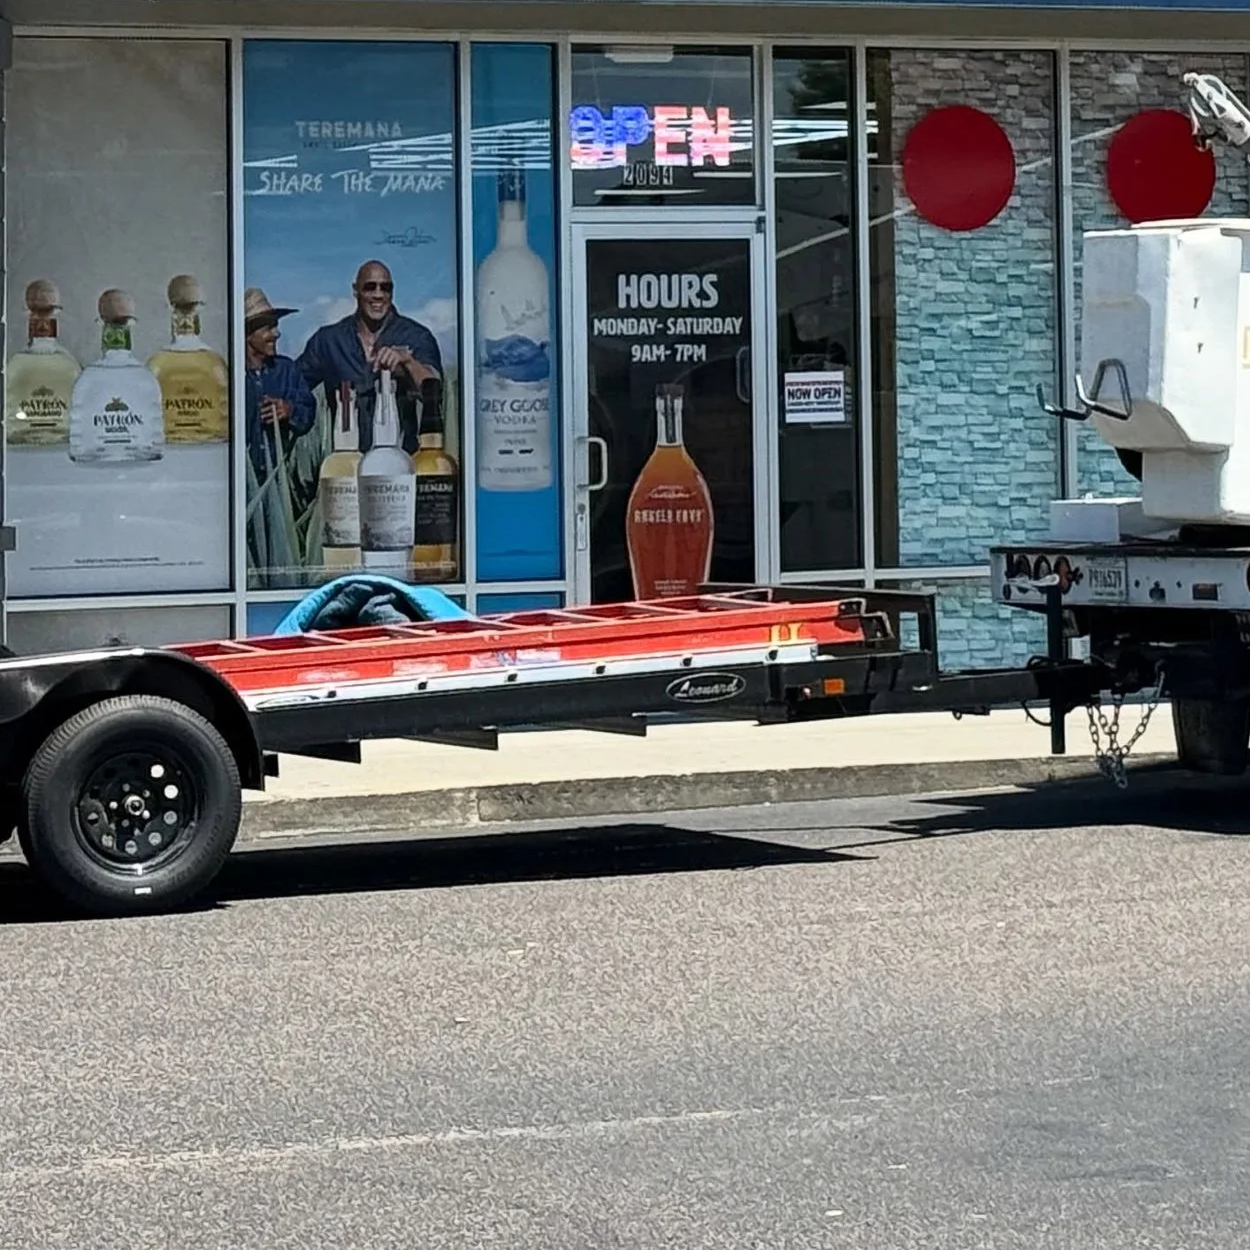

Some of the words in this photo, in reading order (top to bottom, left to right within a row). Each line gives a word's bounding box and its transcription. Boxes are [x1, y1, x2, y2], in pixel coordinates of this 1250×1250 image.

[296, 121, 403, 139] TEREMANA
[569, 105, 730, 168] OPEN
[260, 171, 324, 194] SHARE
[331, 169, 376, 194] THE
[381, 173, 446, 198] MANA
[624, 164, 673, 185] 2094
[617, 273, 719, 309] HOURS
[593, 318, 664, 336] MONDAY-
[666, 316, 743, 335] SATURDAY
[674, 344, 706, 362] 7PM
[787, 388, 811, 400] NOW
[813, 386, 842, 399] OPEN
[494, 415, 536, 425] VODKA
[674, 678, 738, 698] Leonard
